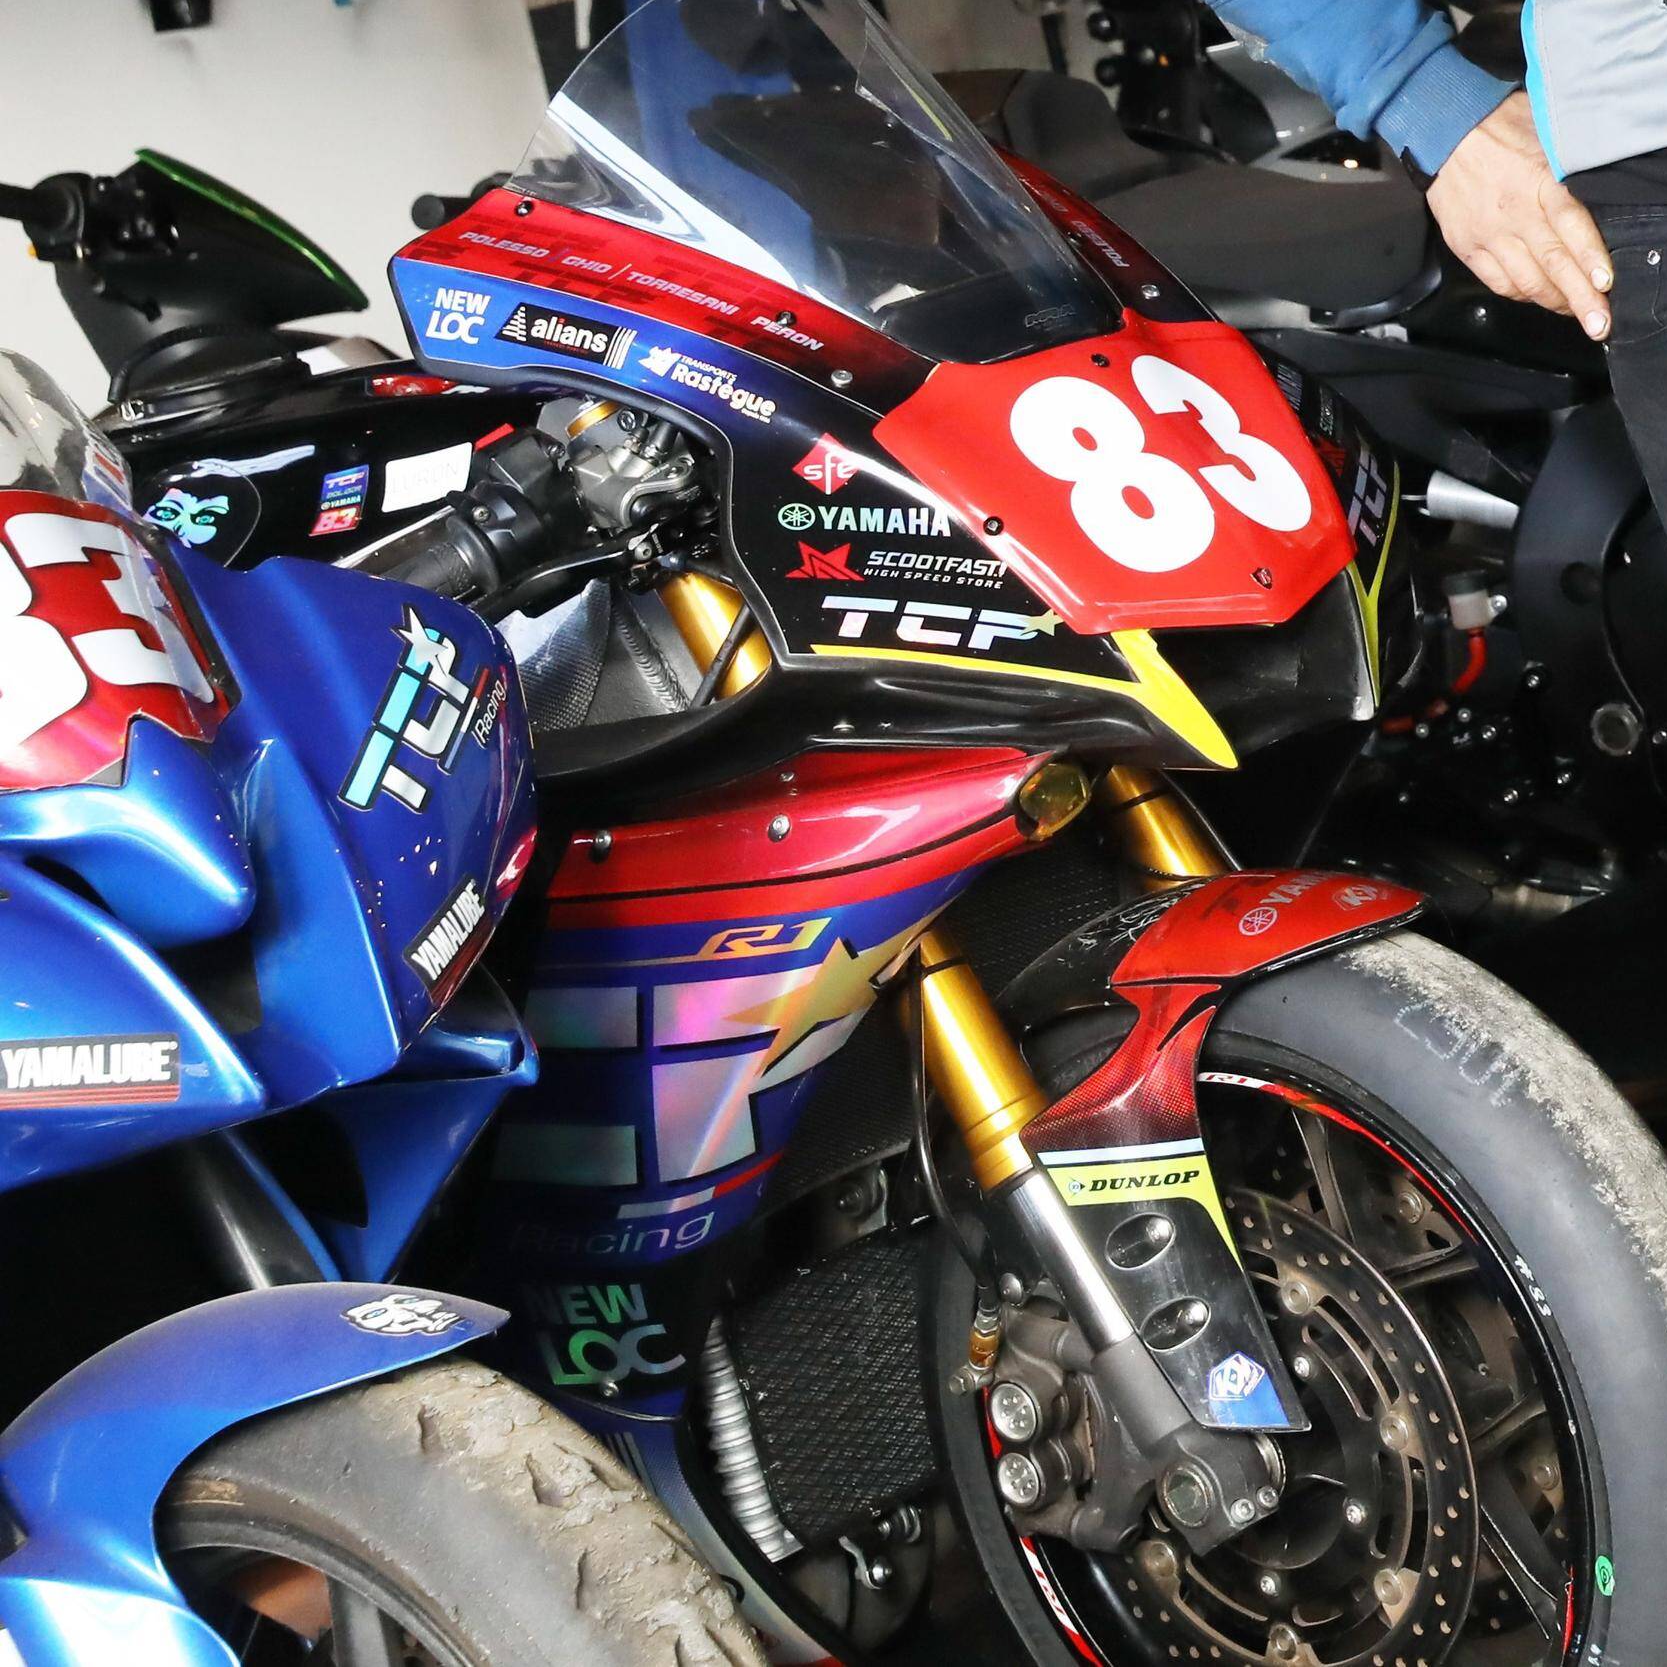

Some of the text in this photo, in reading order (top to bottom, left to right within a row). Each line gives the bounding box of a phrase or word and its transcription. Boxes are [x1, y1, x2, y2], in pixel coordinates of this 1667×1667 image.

[433, 287, 491, 314] NEW
[458, 230, 824, 352] POLESSO GHIO TORRESANI PERON
[425, 309, 486, 345] LOC
[530, 316, 609, 353] alians
[680, 354, 738, 381] TRANSPORTS
[802, 446, 856, 496] sfe
[1009, 354, 1313, 574] 83
[818, 505, 953, 537] YAMAHA
[863, 566, 1005, 591] HIGH SPEED STORE
[821, 595, 1038, 651] TCP
[339, 606, 470, 814] TCP
[471, 679, 507, 751] Racing
[411, 879, 487, 982] YAMALUBE
[0, 1040, 175, 1089] YAMALUBE
[1088, 1170, 1201, 1194] DUNLOP
[506, 1210, 717, 1270] Racing
[523, 1282, 647, 1327] NEW
[548, 1328, 687, 1386] LOC
